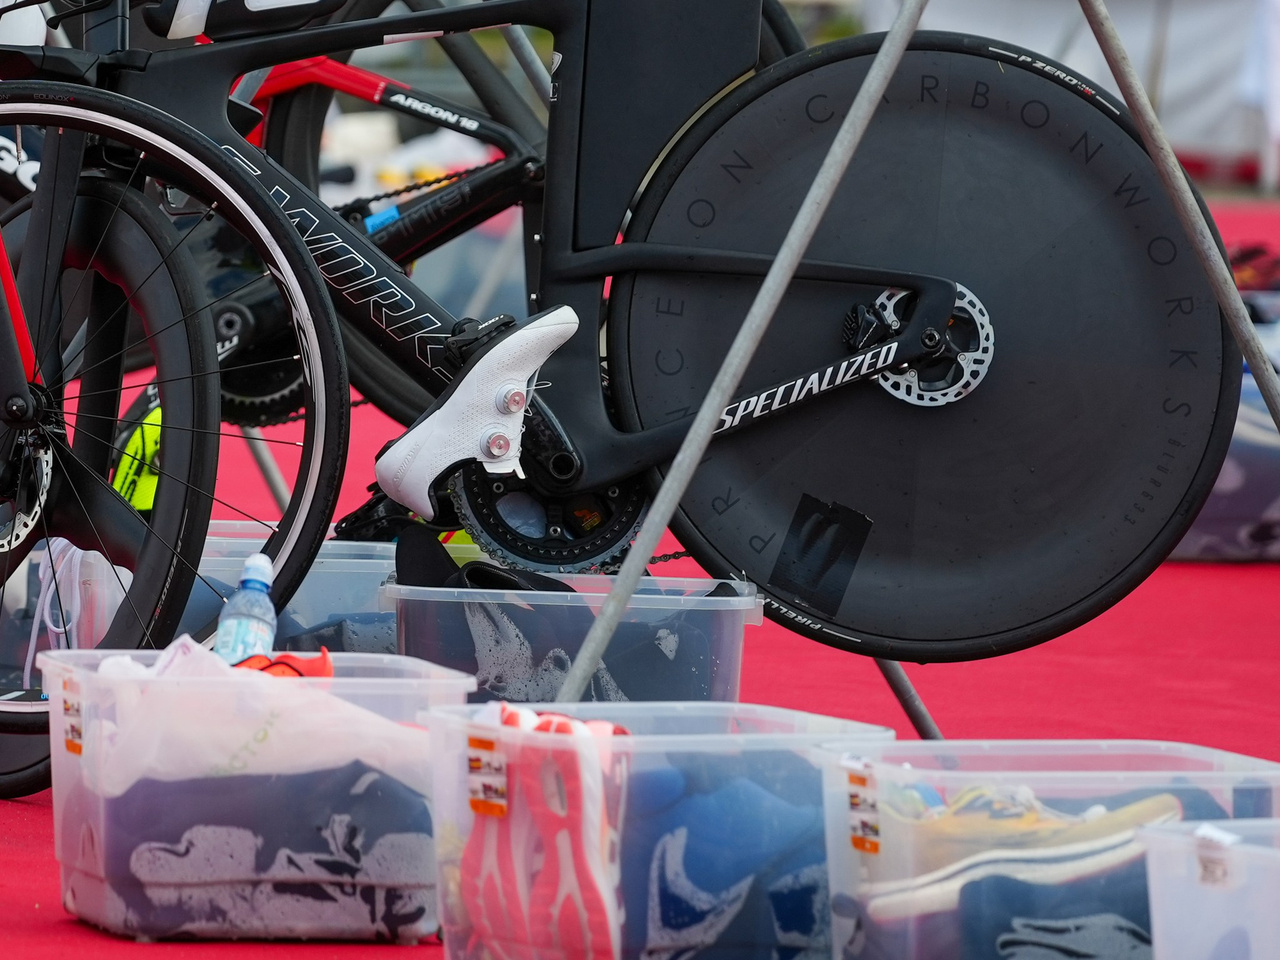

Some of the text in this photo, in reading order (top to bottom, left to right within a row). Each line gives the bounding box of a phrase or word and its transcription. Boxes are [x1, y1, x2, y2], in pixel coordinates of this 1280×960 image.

[1018, 54, 1078, 86] P ZERO
[33, 93, 69, 103] EQUINOX
[389, 93, 480, 131] ARGON 18
[804, 74, 1199, 419] CRBONWORKS
[712, 341, 899, 435] SPECIALIZED
